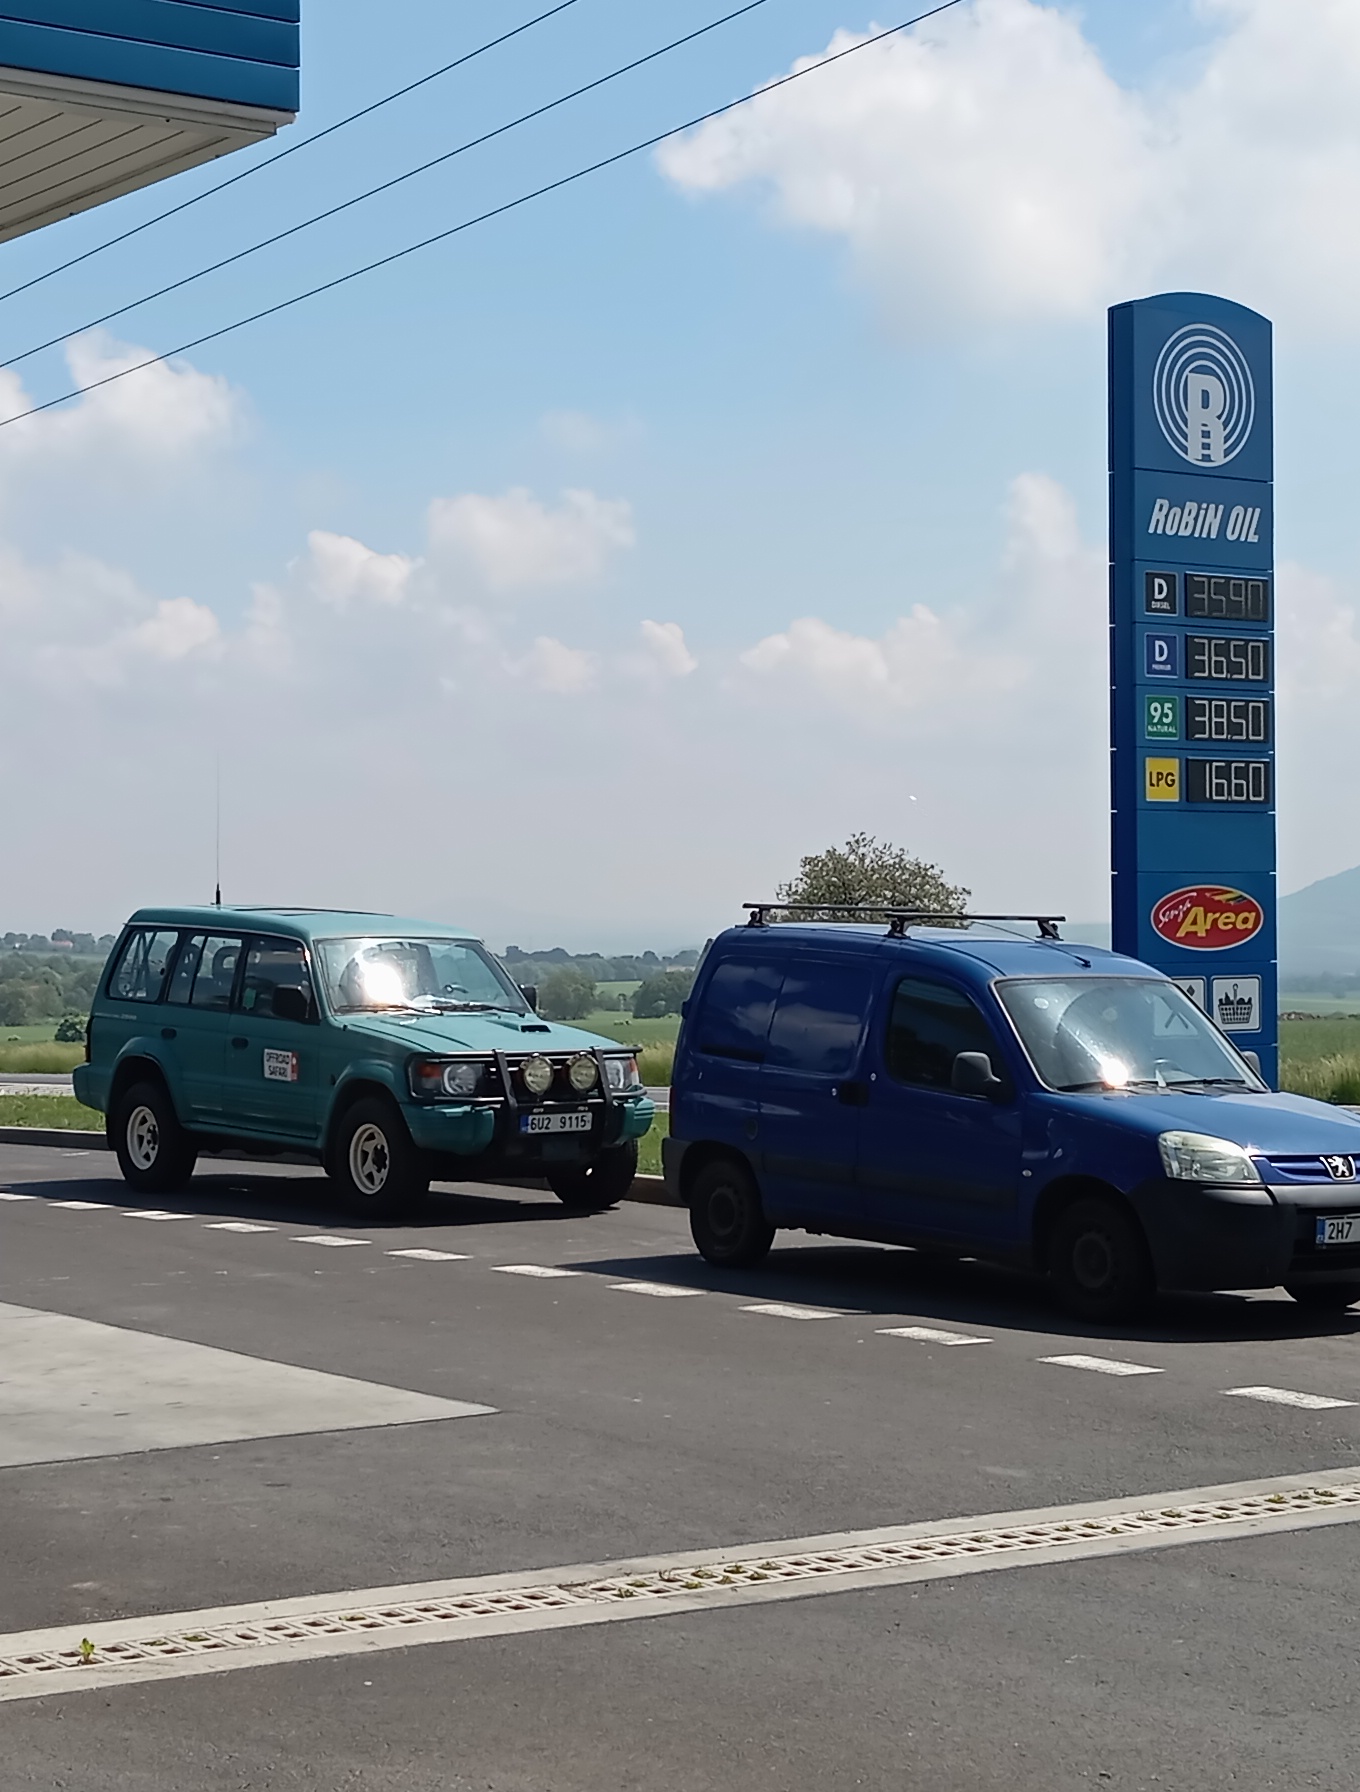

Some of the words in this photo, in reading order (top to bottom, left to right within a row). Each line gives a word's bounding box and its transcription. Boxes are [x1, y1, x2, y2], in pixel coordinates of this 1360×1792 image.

[1226, 505, 1261, 543] OIL
[1154, 577, 1168, 600] D
[1151, 600, 1171, 610] DIESEL
[1155, 640, 1168, 662] D
[1150, 701, 1173, 724] 95
[1147, 724, 1177, 733] NATURAL
[1149, 771, 1176, 788] LPG
[1176, 906, 1256, 938] Area
[530, 1116, 552, 1131] 6U2
[559, 1114, 588, 1129] 9115
[1328, 1221, 1353, 1240] 2H7
